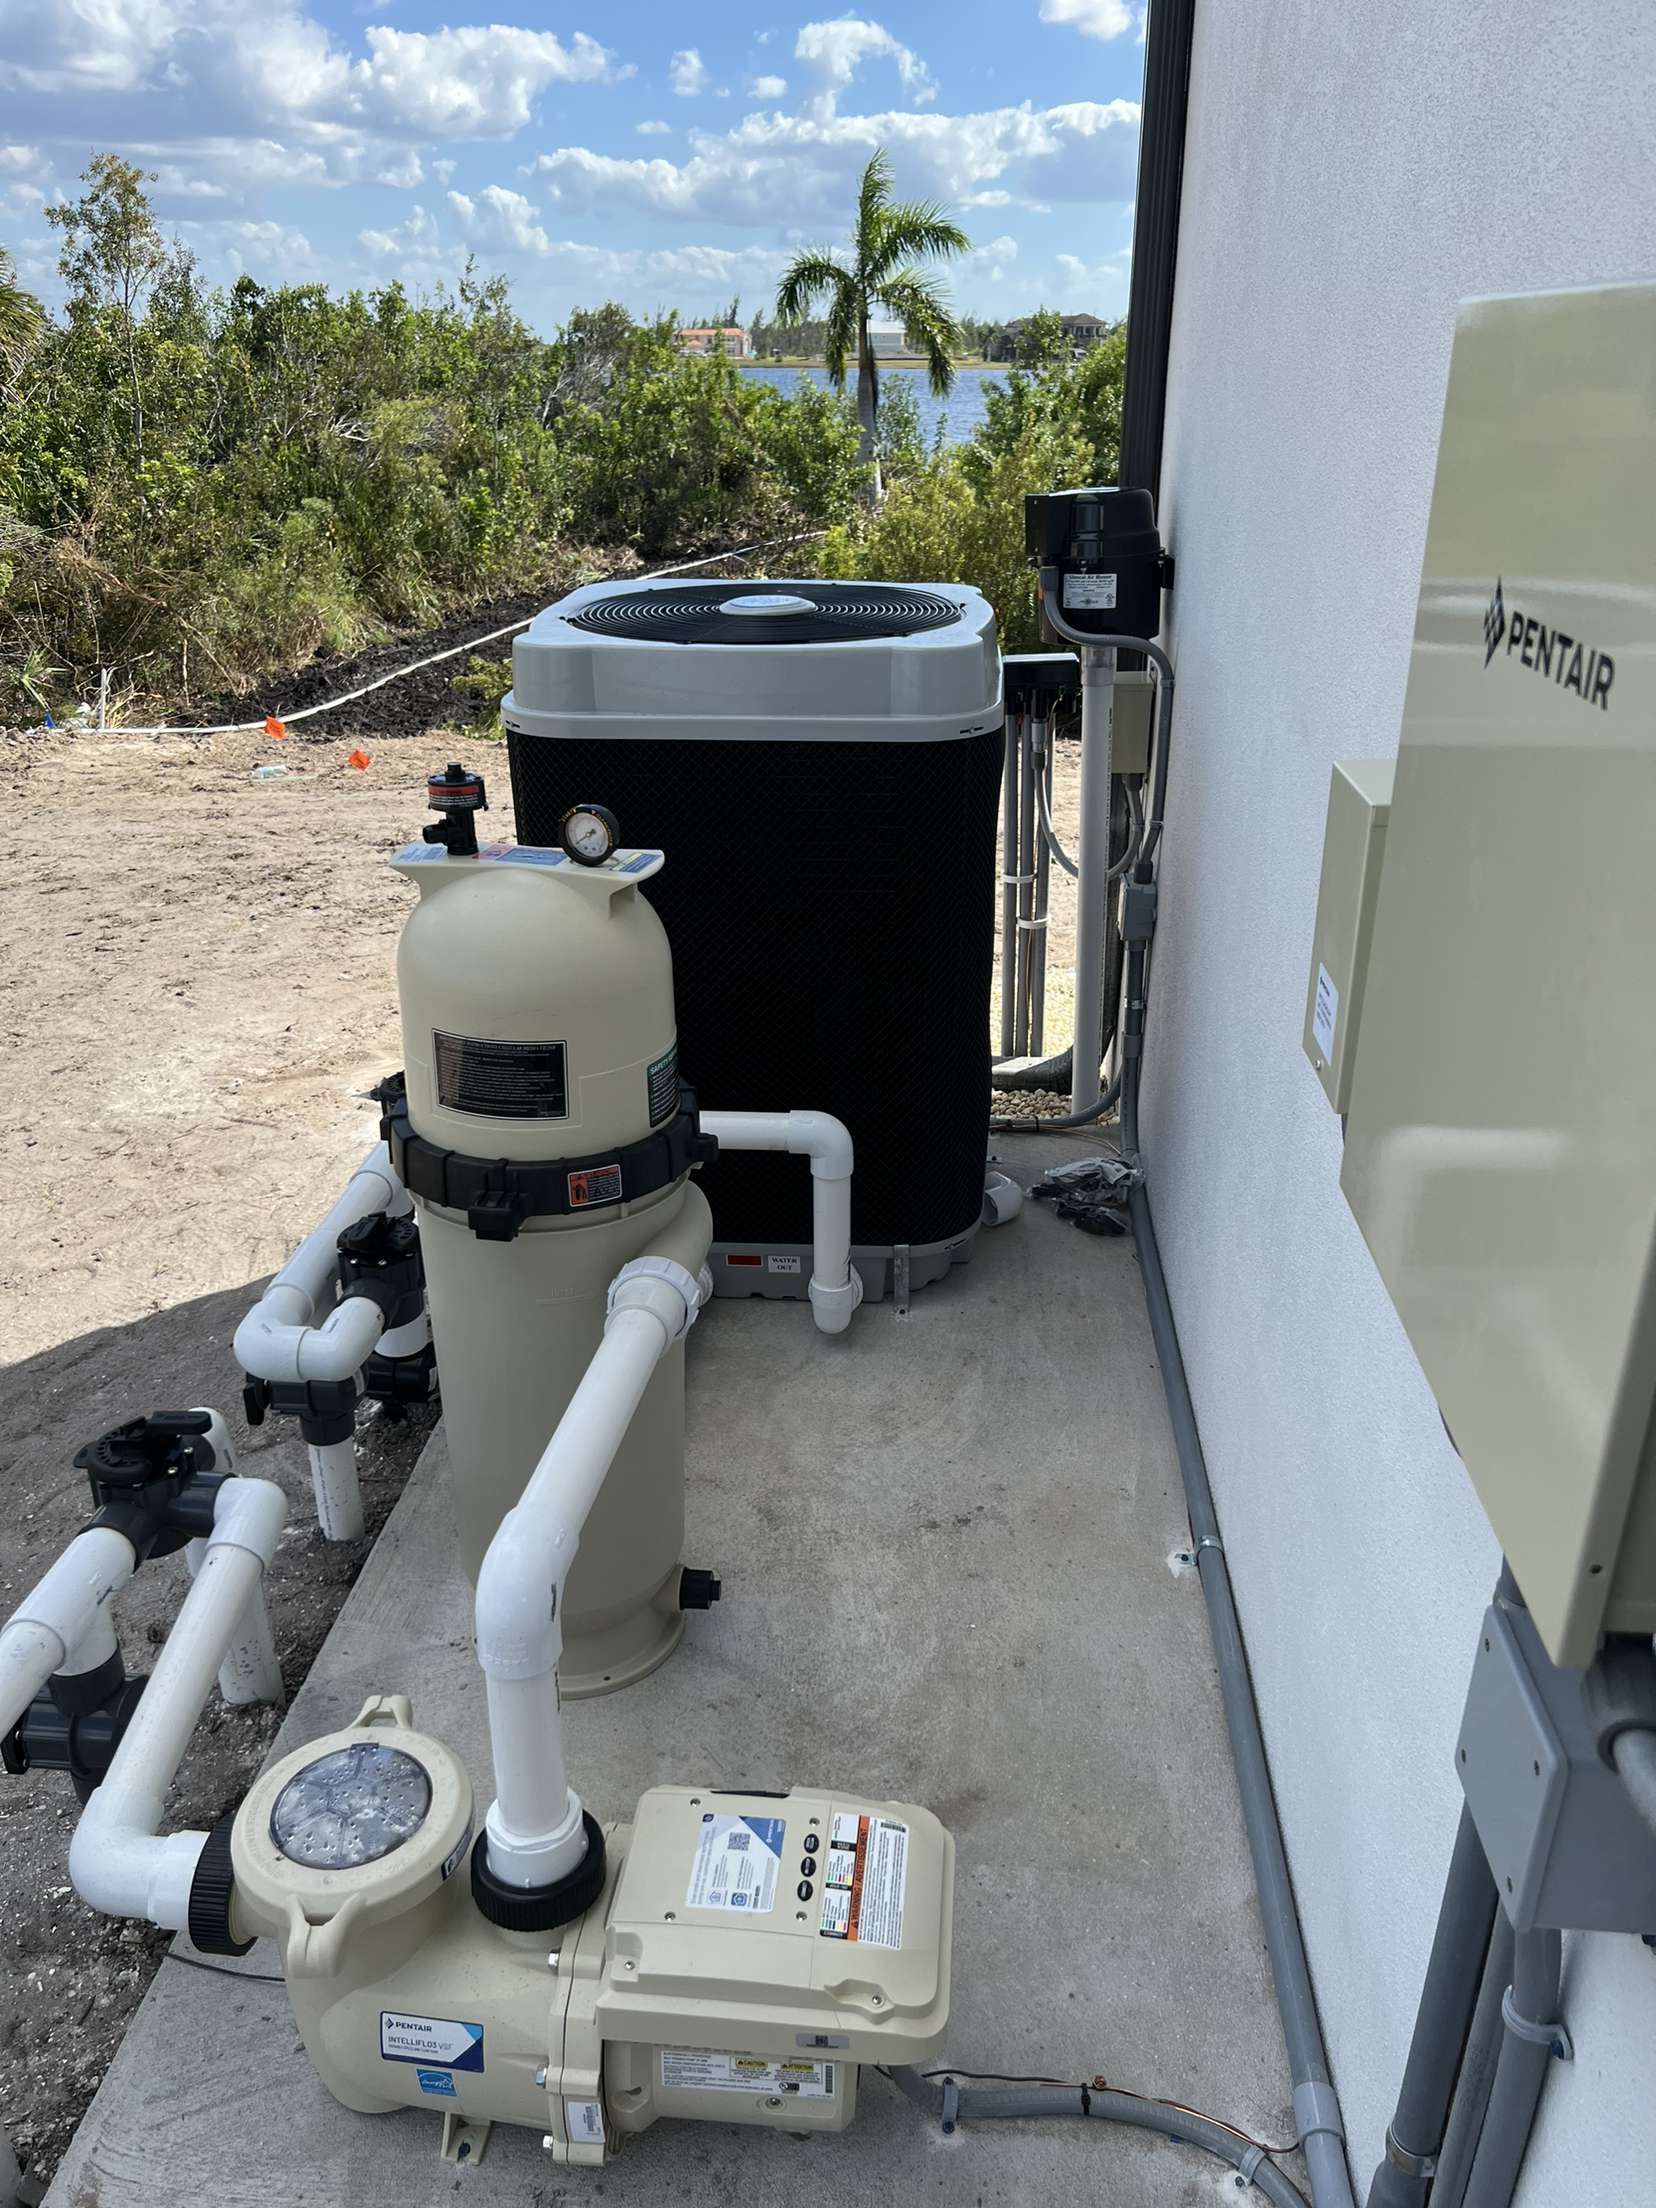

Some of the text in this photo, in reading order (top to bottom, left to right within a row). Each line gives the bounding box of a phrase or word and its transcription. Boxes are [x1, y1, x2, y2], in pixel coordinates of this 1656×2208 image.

[1507, 610, 1616, 711] PENTAIR
[771, 1257, 797, 1265] WATER
[852, 1887, 862, 1921] WARNING
[395, 2021, 433, 2033] PENTAIR
